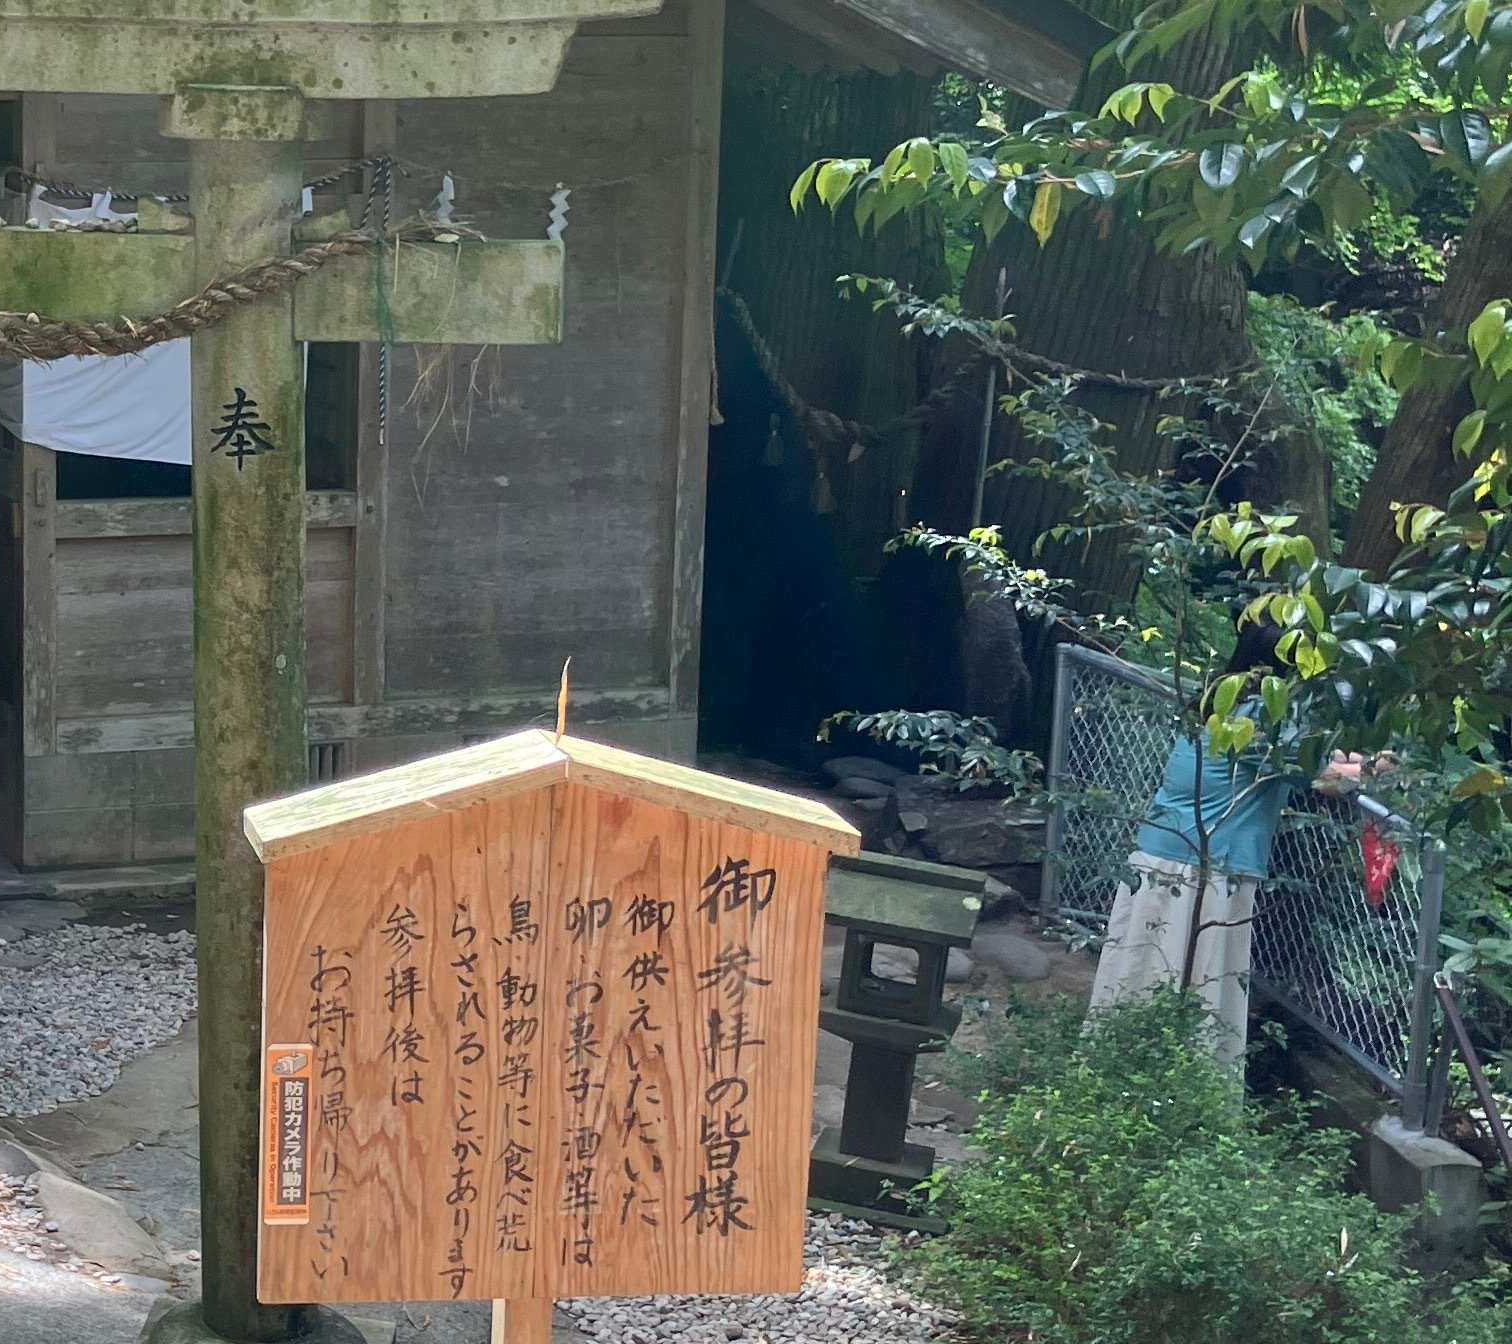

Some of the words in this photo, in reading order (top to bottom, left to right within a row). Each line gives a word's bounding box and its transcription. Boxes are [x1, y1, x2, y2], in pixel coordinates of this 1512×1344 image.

[210, 387, 275, 471] 奉
[282, 1081, 305, 1203] 防犯カメラ作動中
[307, 944, 355, 1281] お持ち帰り下さい
[379, 902, 430, 1107] 参拝後は
[438, 902, 488, 1301] らされることがあります
[620, 893, 675, 1227] 御供えいただいた
[682, 856, 777, 1237] 御参拝の皆様
